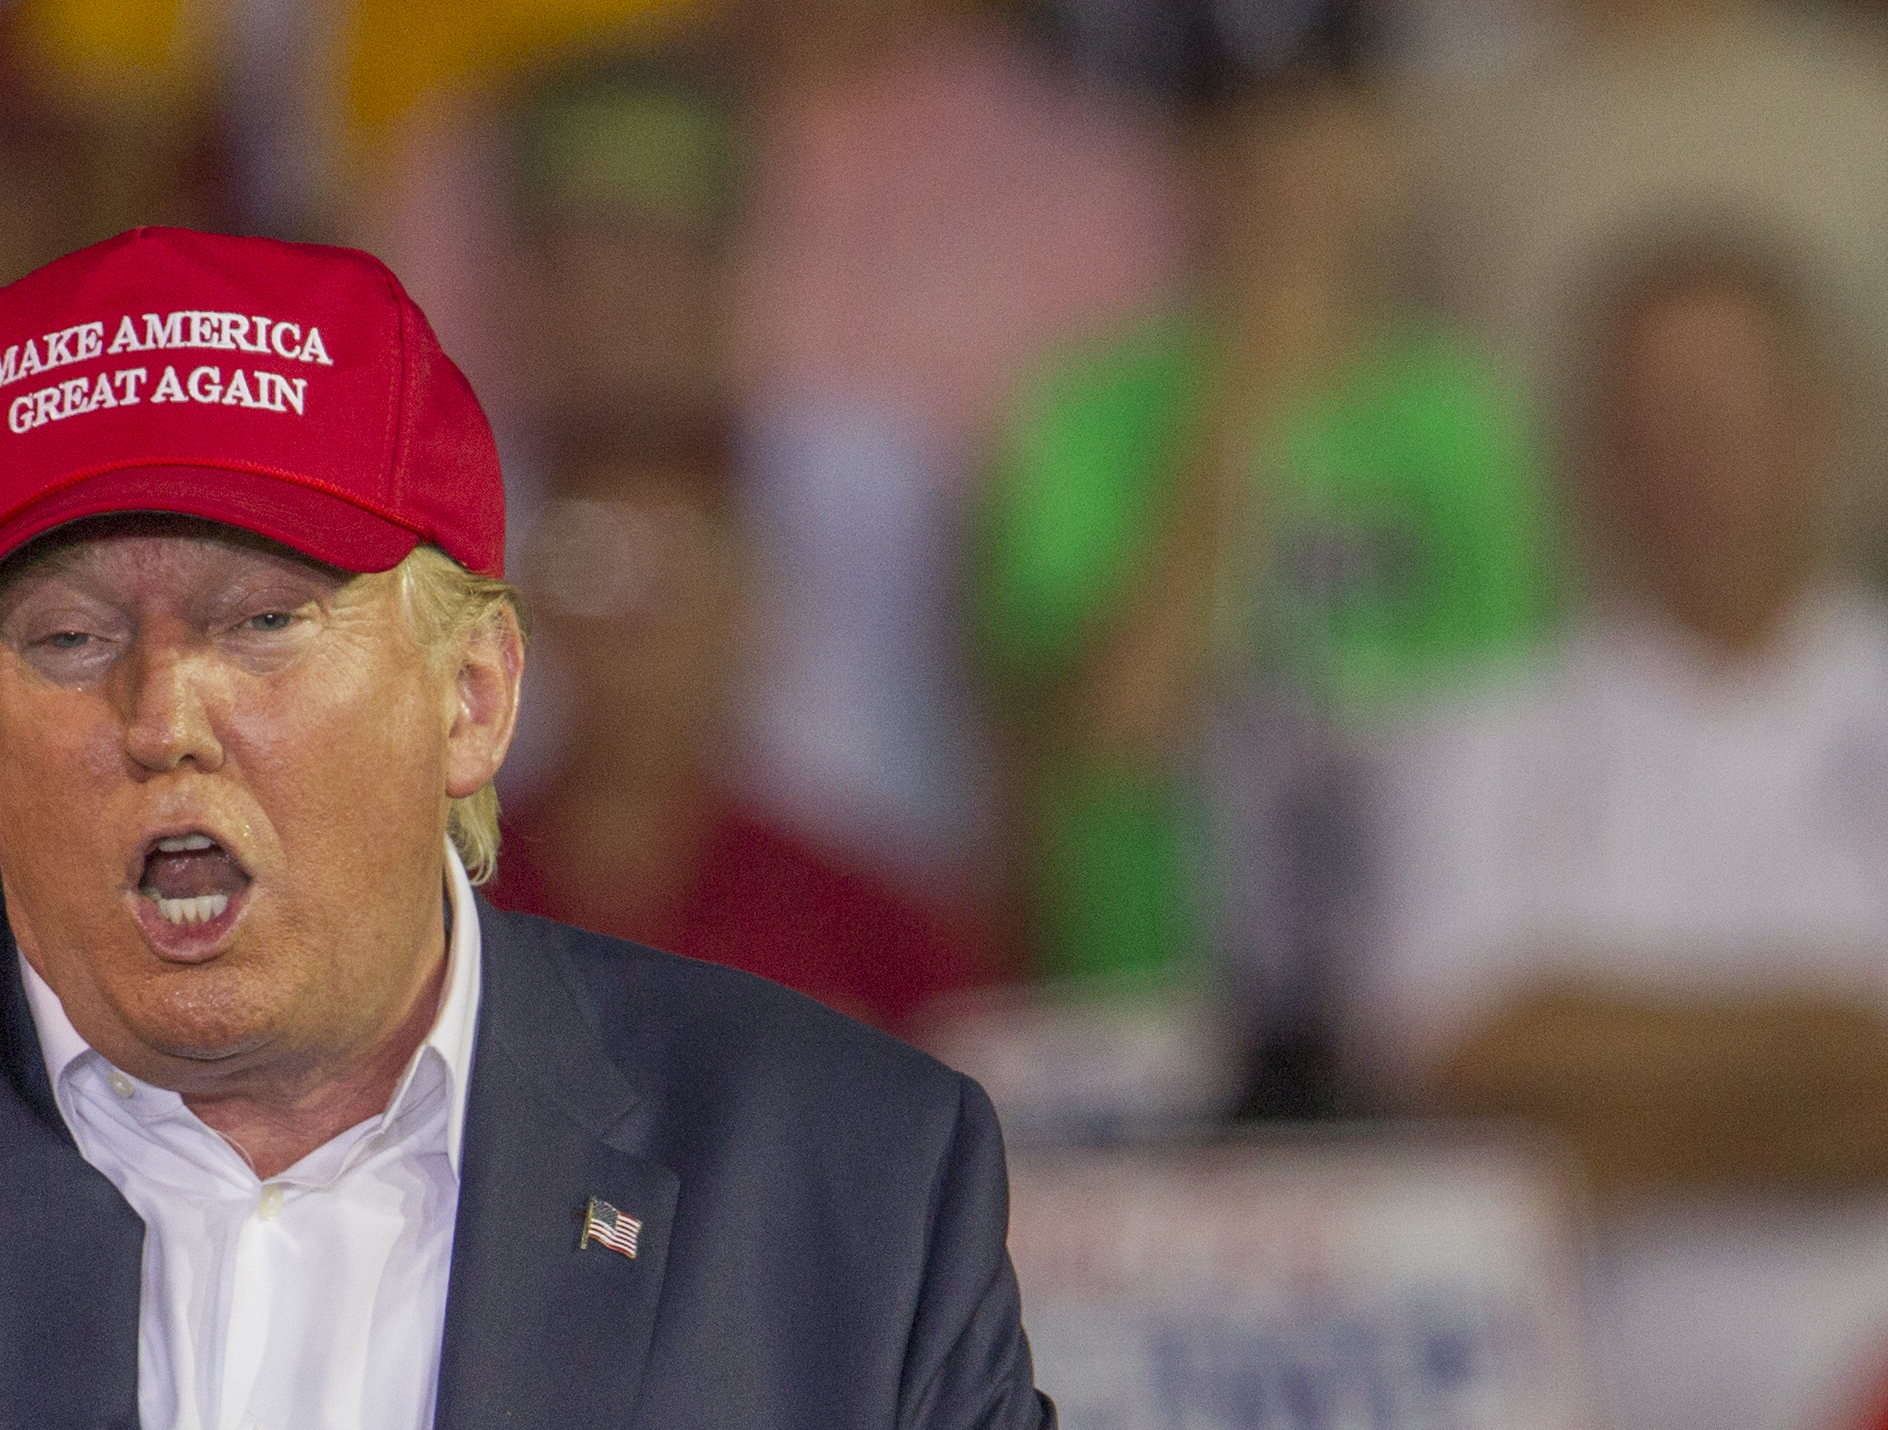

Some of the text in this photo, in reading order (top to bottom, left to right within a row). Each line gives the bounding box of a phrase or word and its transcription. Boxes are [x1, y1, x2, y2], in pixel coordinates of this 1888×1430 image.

[107, 310, 334, 366] AMERICA
[8, 365, 308, 434] GREAT AGAIN
